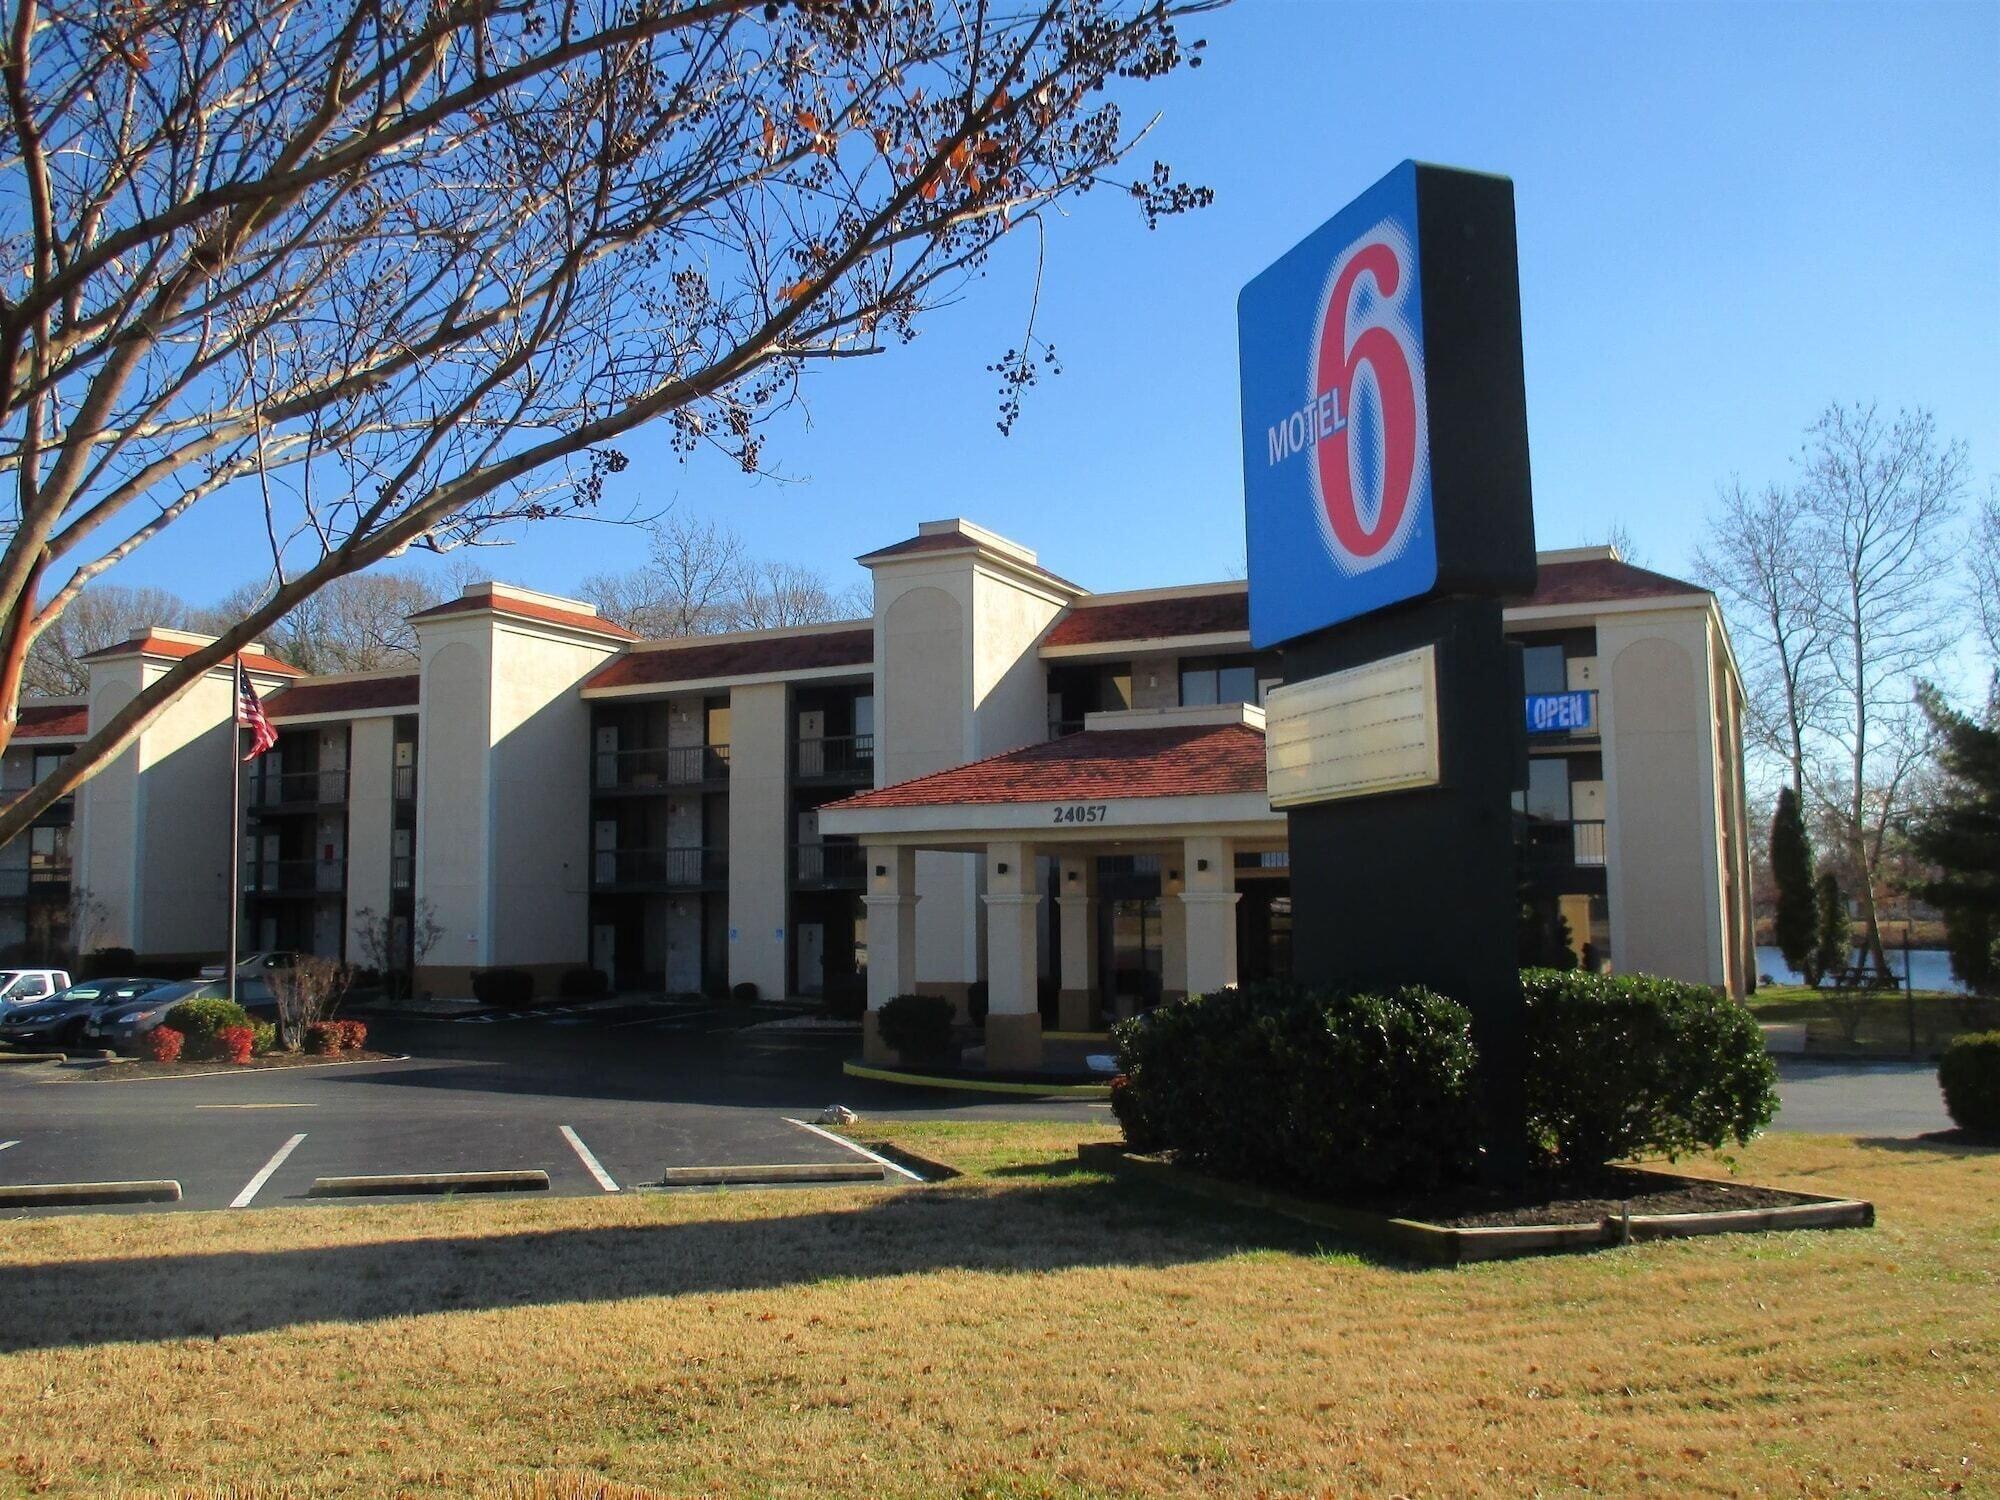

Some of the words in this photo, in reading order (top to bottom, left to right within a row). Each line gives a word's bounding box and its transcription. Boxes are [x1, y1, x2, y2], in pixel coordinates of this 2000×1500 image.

[1268, 387, 1346, 467] MOTEL
[1316, 242, 1417, 558] 6
[1533, 693, 1584, 729] OPEN
[1053, 805, 1107, 823] 24057
